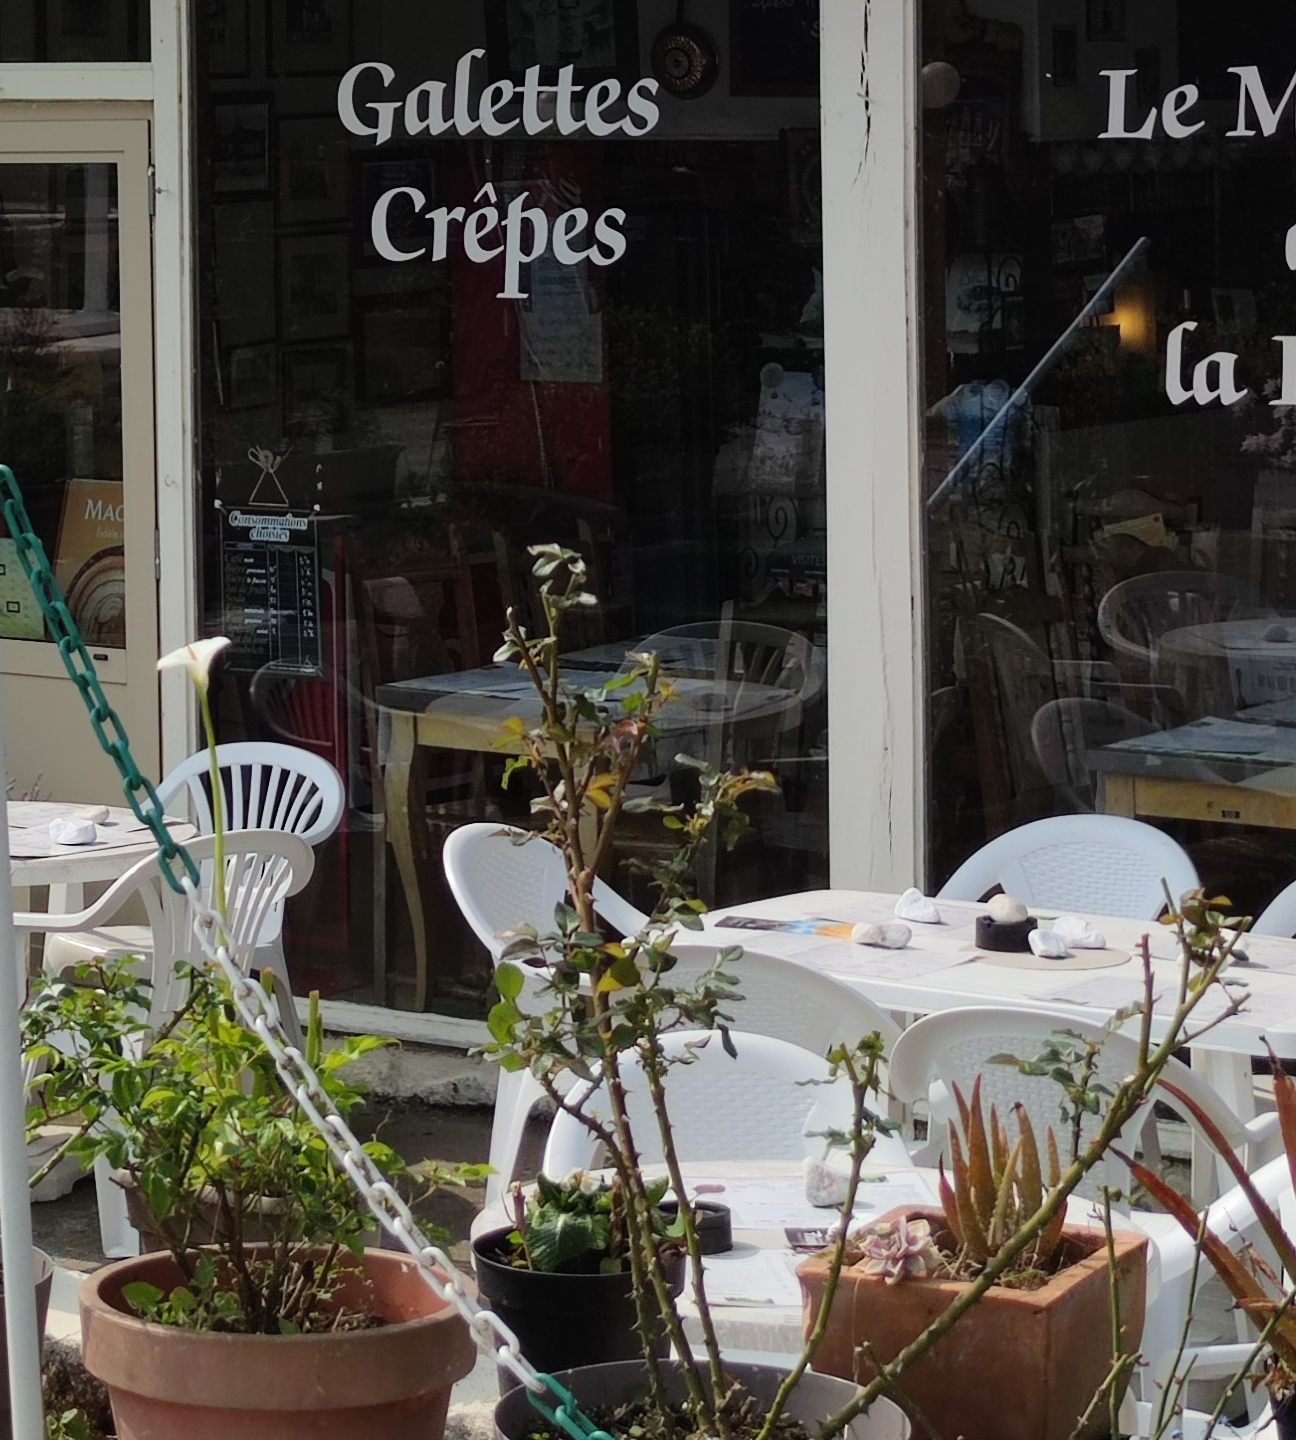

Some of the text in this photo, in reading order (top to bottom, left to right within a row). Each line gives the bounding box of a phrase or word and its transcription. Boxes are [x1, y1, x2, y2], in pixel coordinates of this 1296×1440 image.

[338, 49, 660, 146] Galettes
[1098, 69, 1205, 139] Le
[371, 182, 627, 299] Crêpes
[1166, 322, 1248, 406] la
[229, 510, 309, 530] Consommations
[249, 527, 290, 541] choisies
